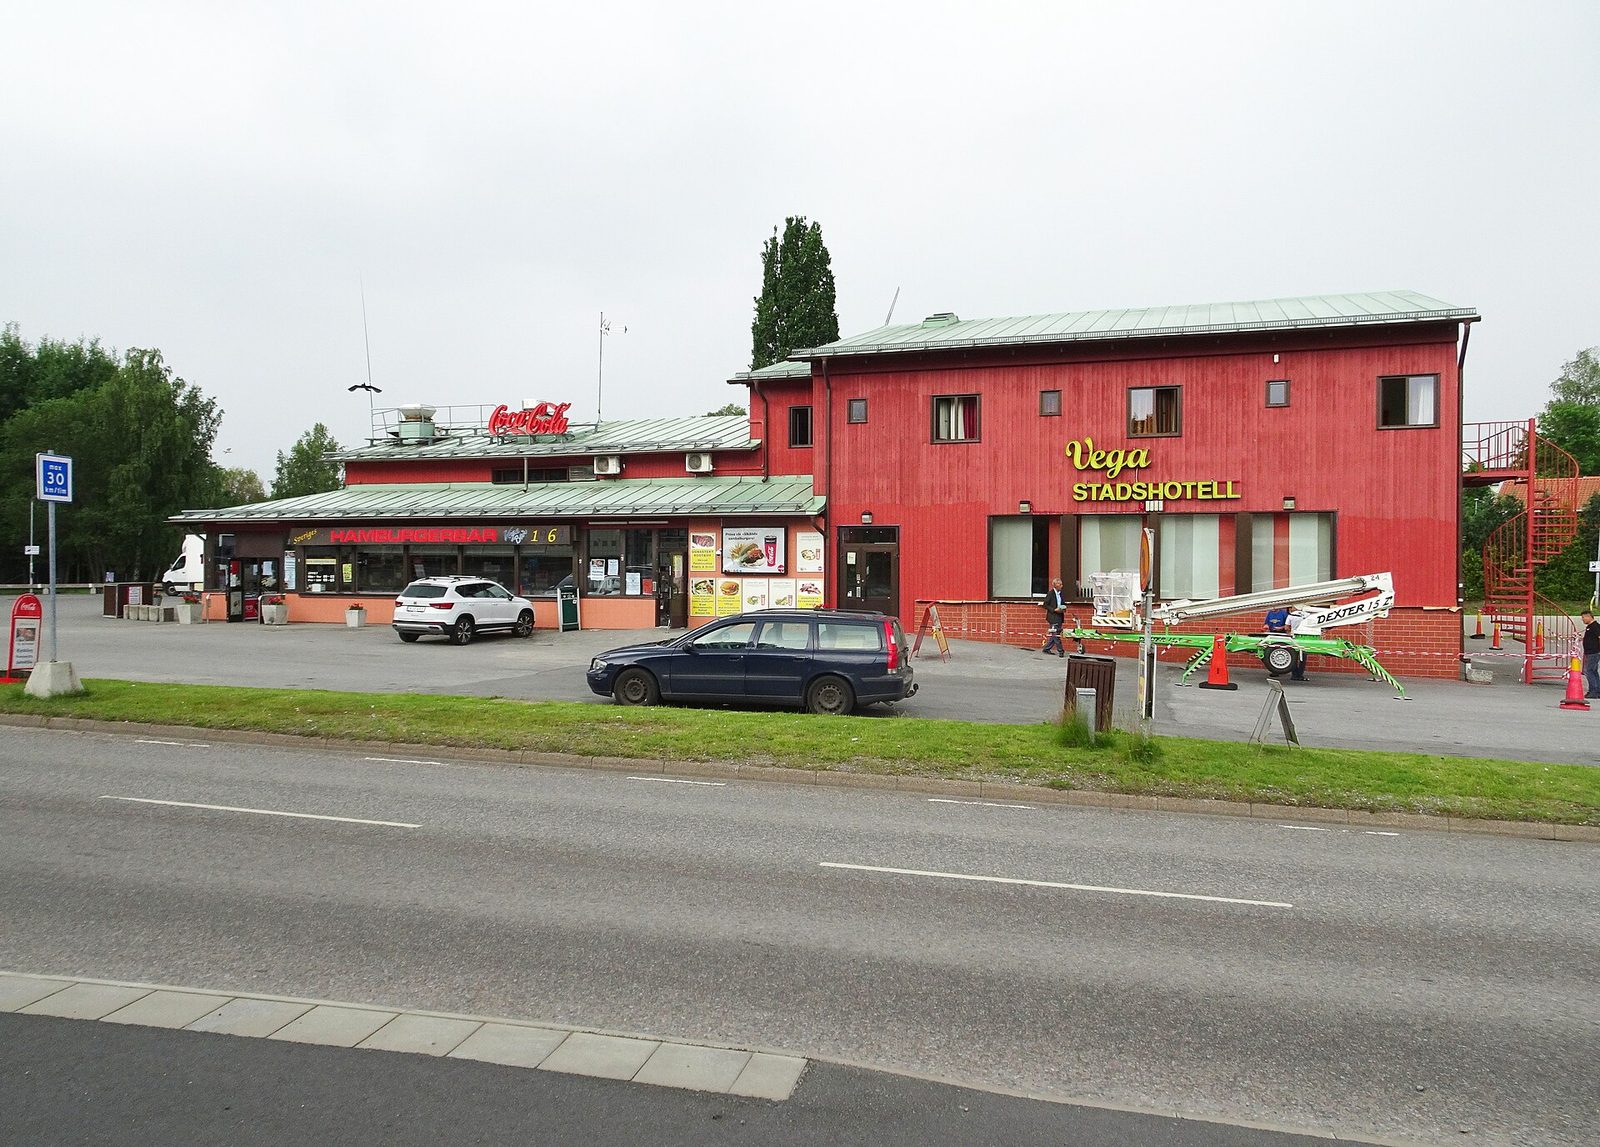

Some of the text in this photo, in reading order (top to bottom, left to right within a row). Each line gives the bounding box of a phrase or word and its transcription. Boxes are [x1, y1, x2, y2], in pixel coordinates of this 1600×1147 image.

[1065, 437, 1152, 479] Vega
[47, 472, 64, 485] 30
[1072, 481, 1241, 501] STADSHOTELL
[330, 528, 497, 543] HAMBURGERBAR
[1317, 604, 1365, 624] DEXTER
[1368, 600, 1380, 610] 15
